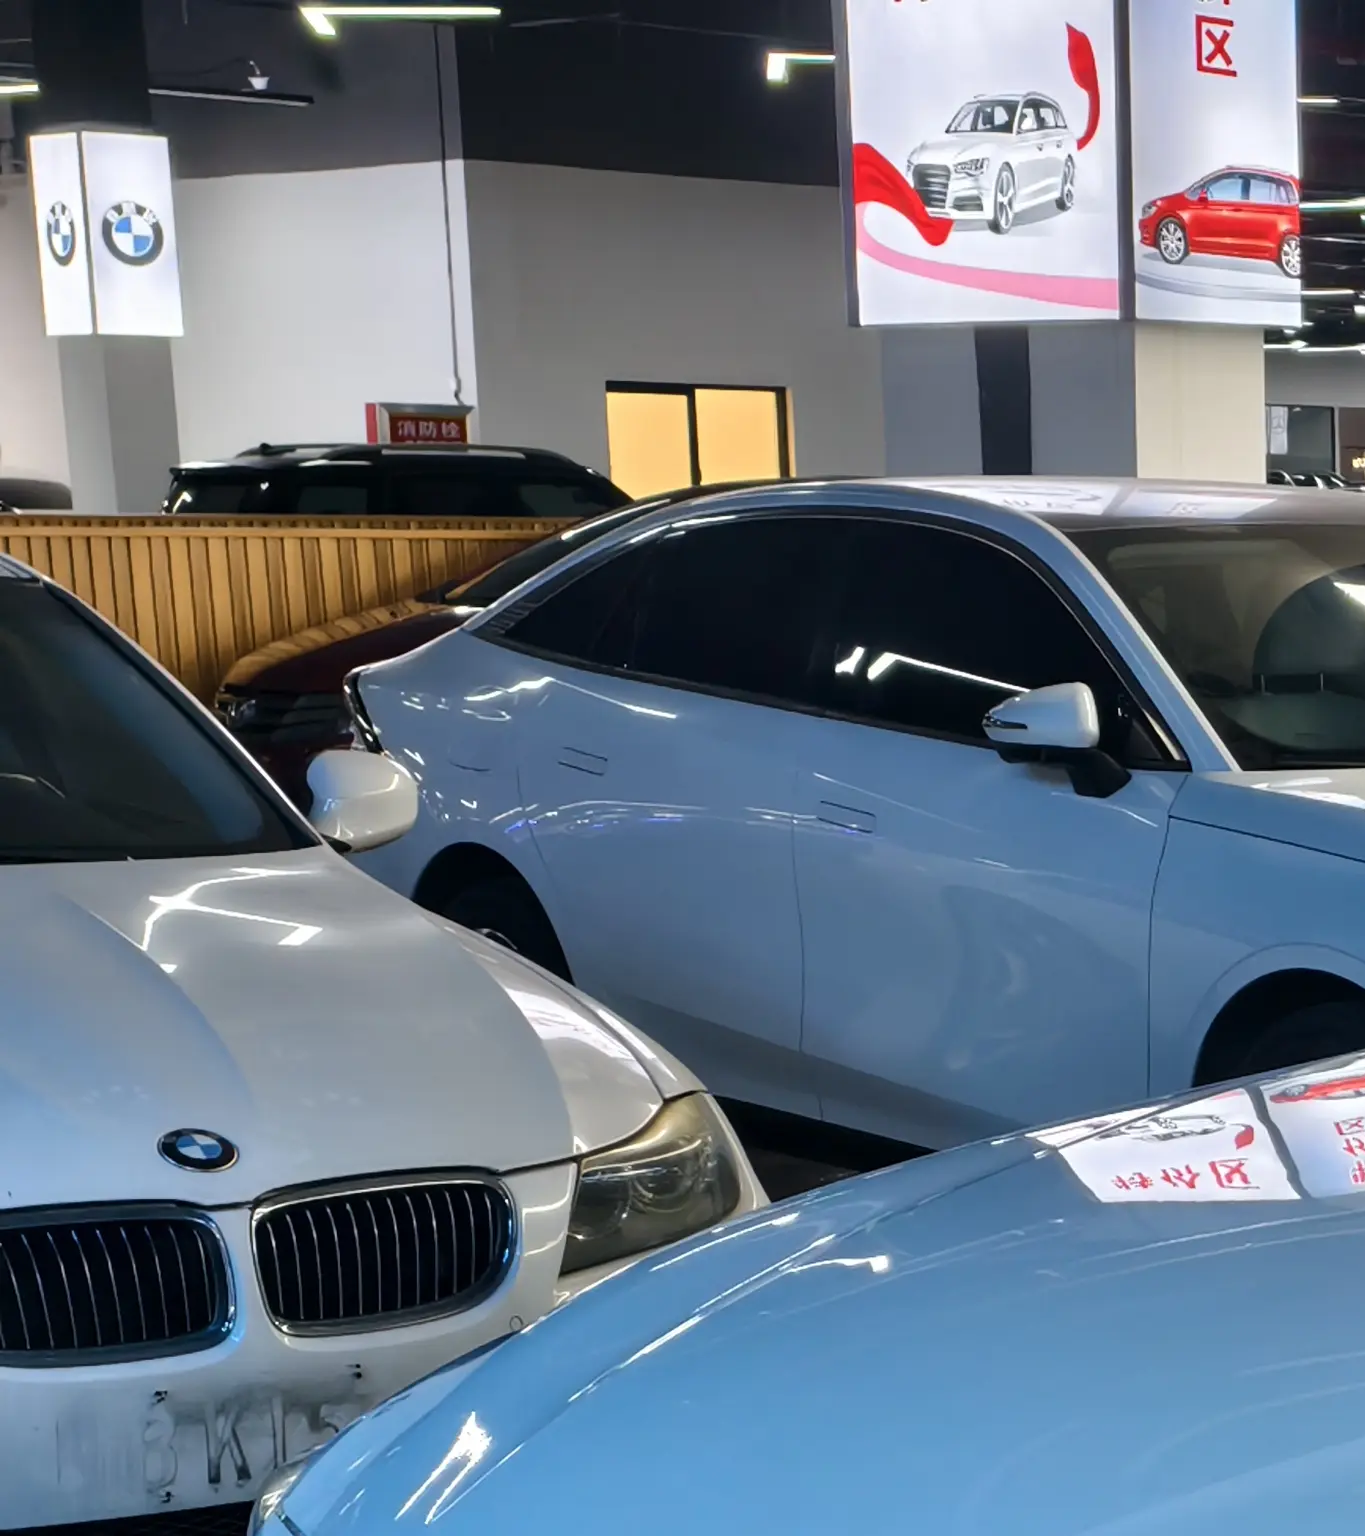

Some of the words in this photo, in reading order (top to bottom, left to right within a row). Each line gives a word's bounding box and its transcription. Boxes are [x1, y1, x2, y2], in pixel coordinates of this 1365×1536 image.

[1194, 0, 1237, 77] 区
[398, 420, 461, 438] 消防栓
